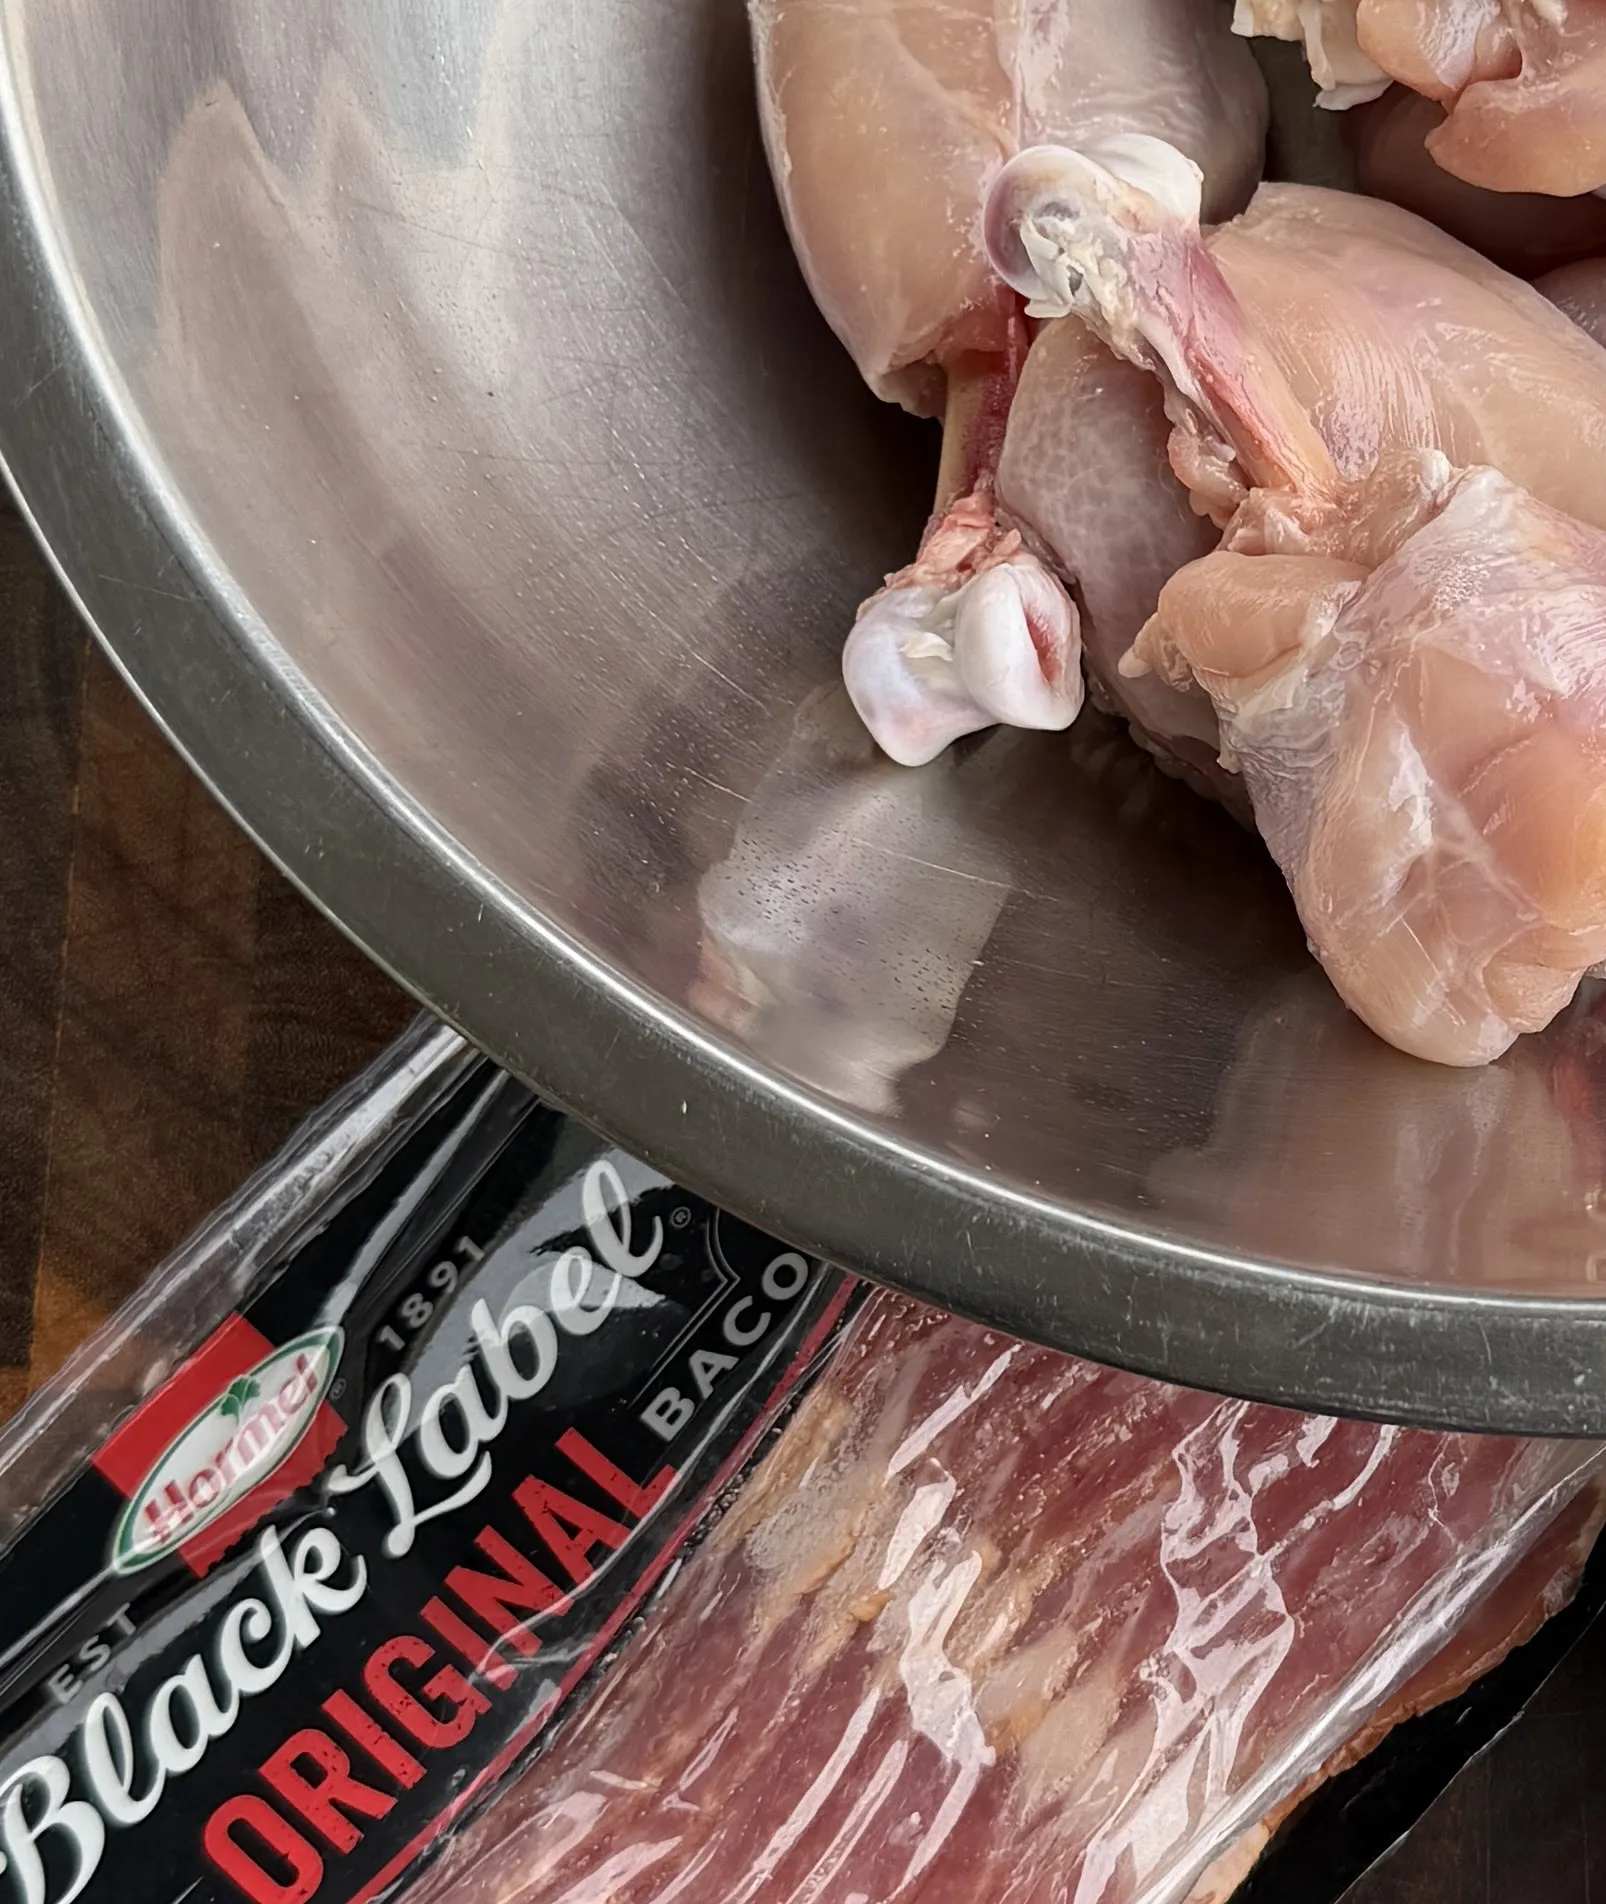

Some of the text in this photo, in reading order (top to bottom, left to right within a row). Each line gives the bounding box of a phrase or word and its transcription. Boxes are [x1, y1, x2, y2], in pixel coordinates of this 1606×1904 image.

[48, 1235, 485, 1704] EST 1891
[144, 1353, 319, 1544] Hormel
[326, 1160, 664, 1558] Label
